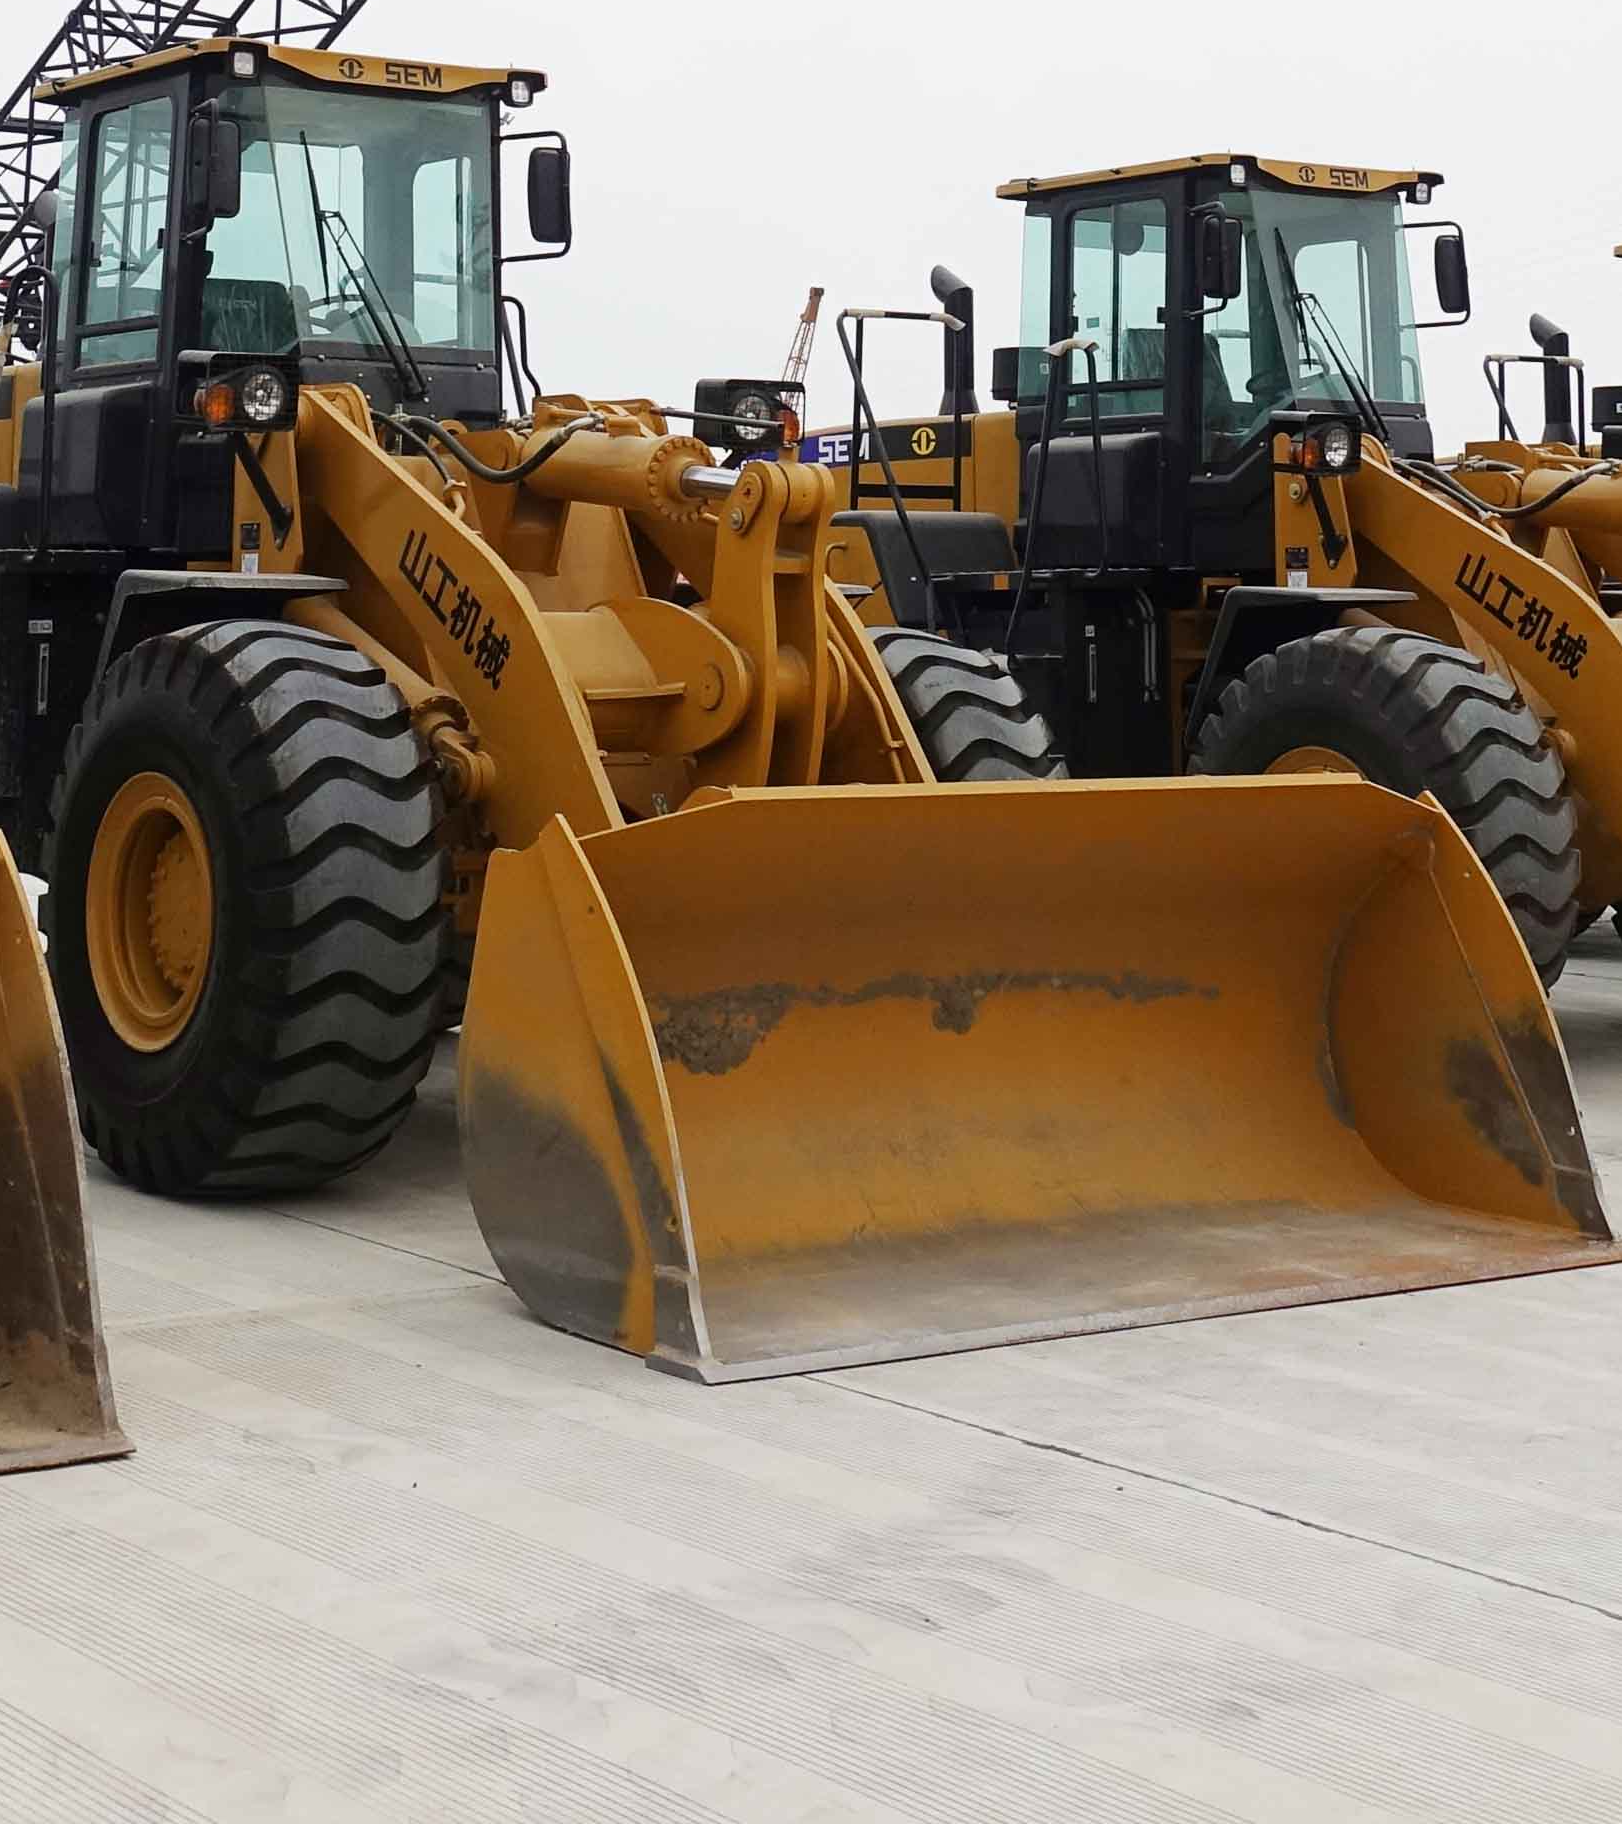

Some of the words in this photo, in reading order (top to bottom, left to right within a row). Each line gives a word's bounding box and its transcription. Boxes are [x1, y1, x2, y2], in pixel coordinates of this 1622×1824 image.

[385, 62, 442, 88] SEM
[1329, 168, 1369, 189] SEM
[399, 529, 510, 690] 山工机械
[1454, 553, 1588, 680] 山工机械
